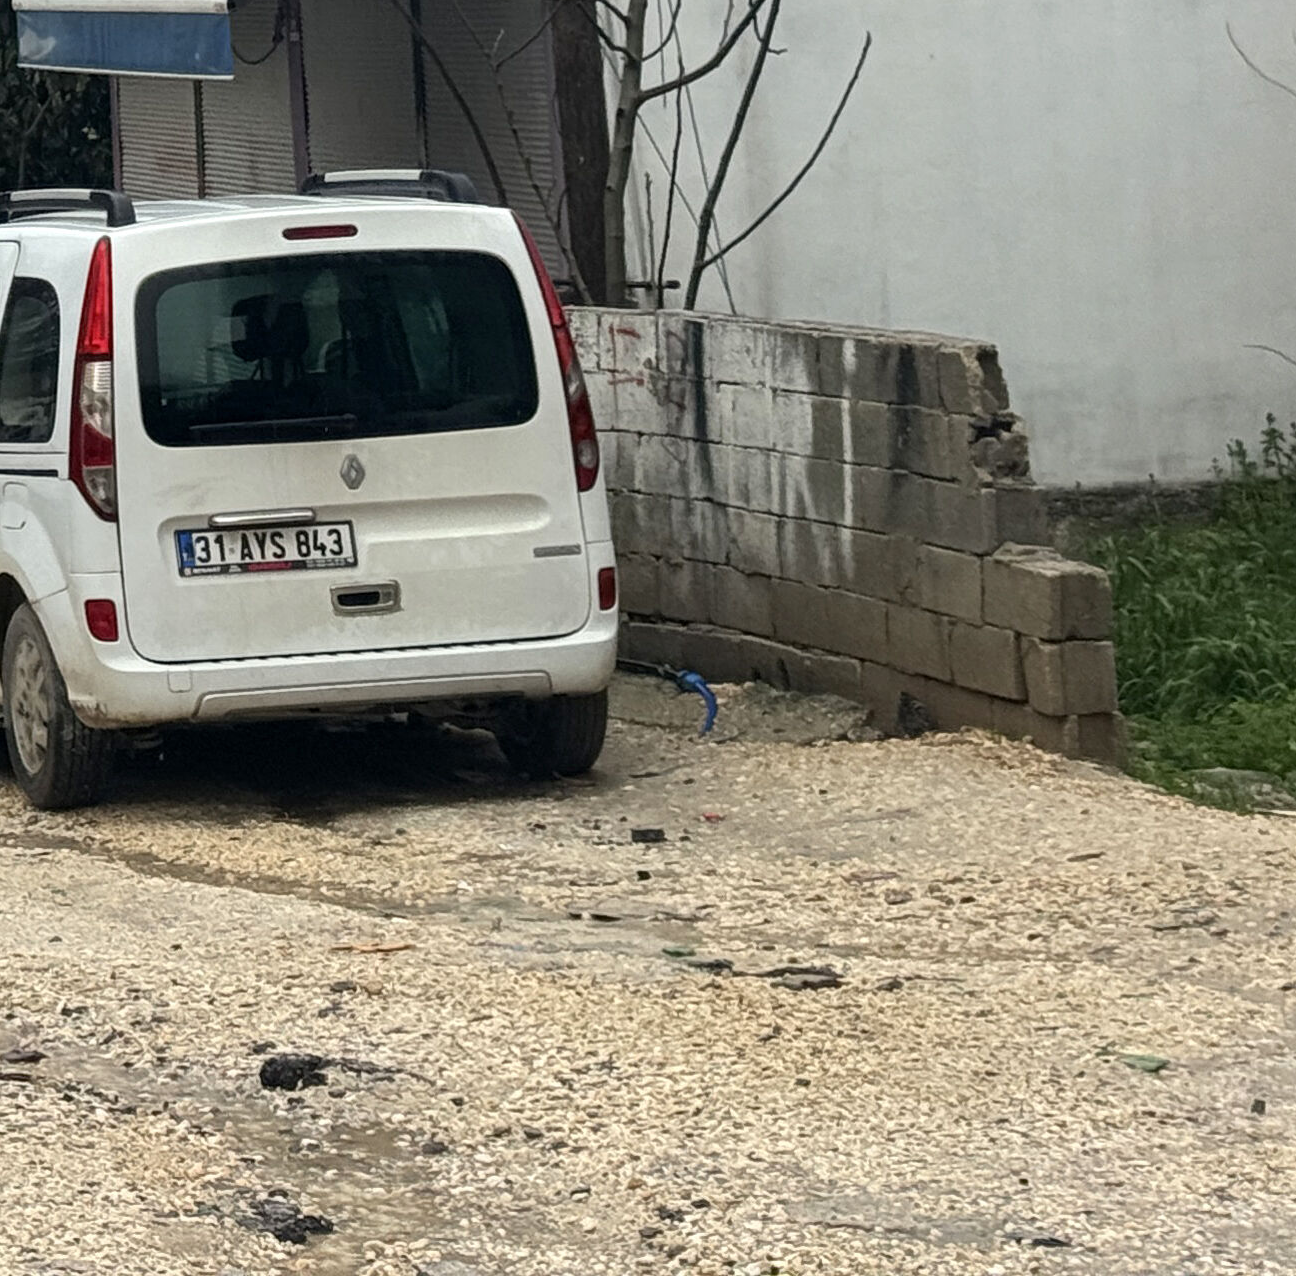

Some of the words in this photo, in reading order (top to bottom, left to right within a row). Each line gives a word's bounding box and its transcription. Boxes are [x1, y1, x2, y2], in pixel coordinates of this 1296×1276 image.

[195, 534, 226, 564] 31
[240, 531, 286, 561] AYS
[295, 529, 344, 559] 843
